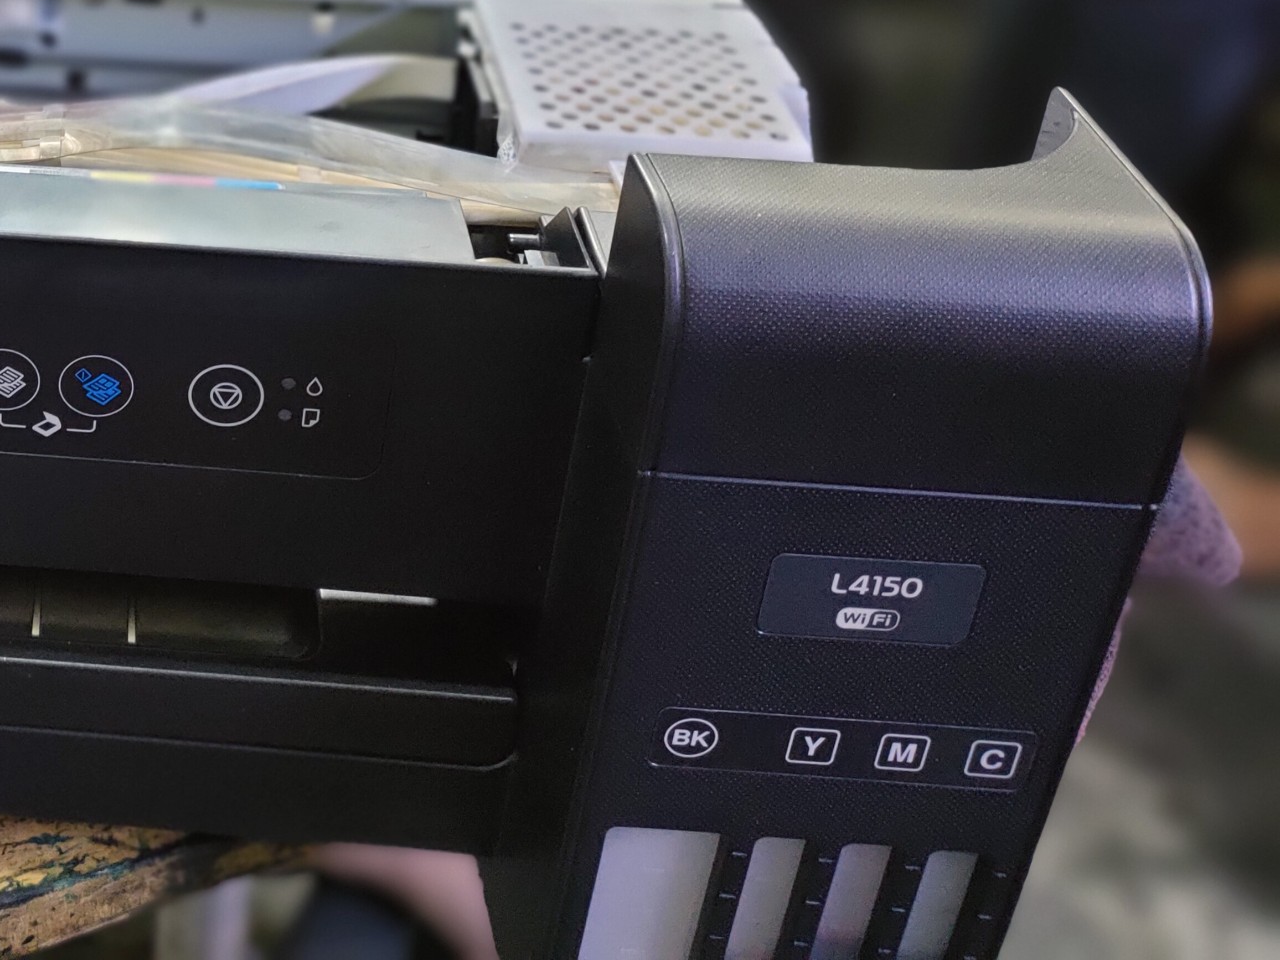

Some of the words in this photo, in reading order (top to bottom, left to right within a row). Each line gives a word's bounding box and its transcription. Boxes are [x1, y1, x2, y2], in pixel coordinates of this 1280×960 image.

[830, 572, 924, 599] L4150
[670, 729, 711, 748] BK
[804, 735, 826, 757] Y
[886, 742, 918, 764] M
[980, 749, 1006, 770] C
